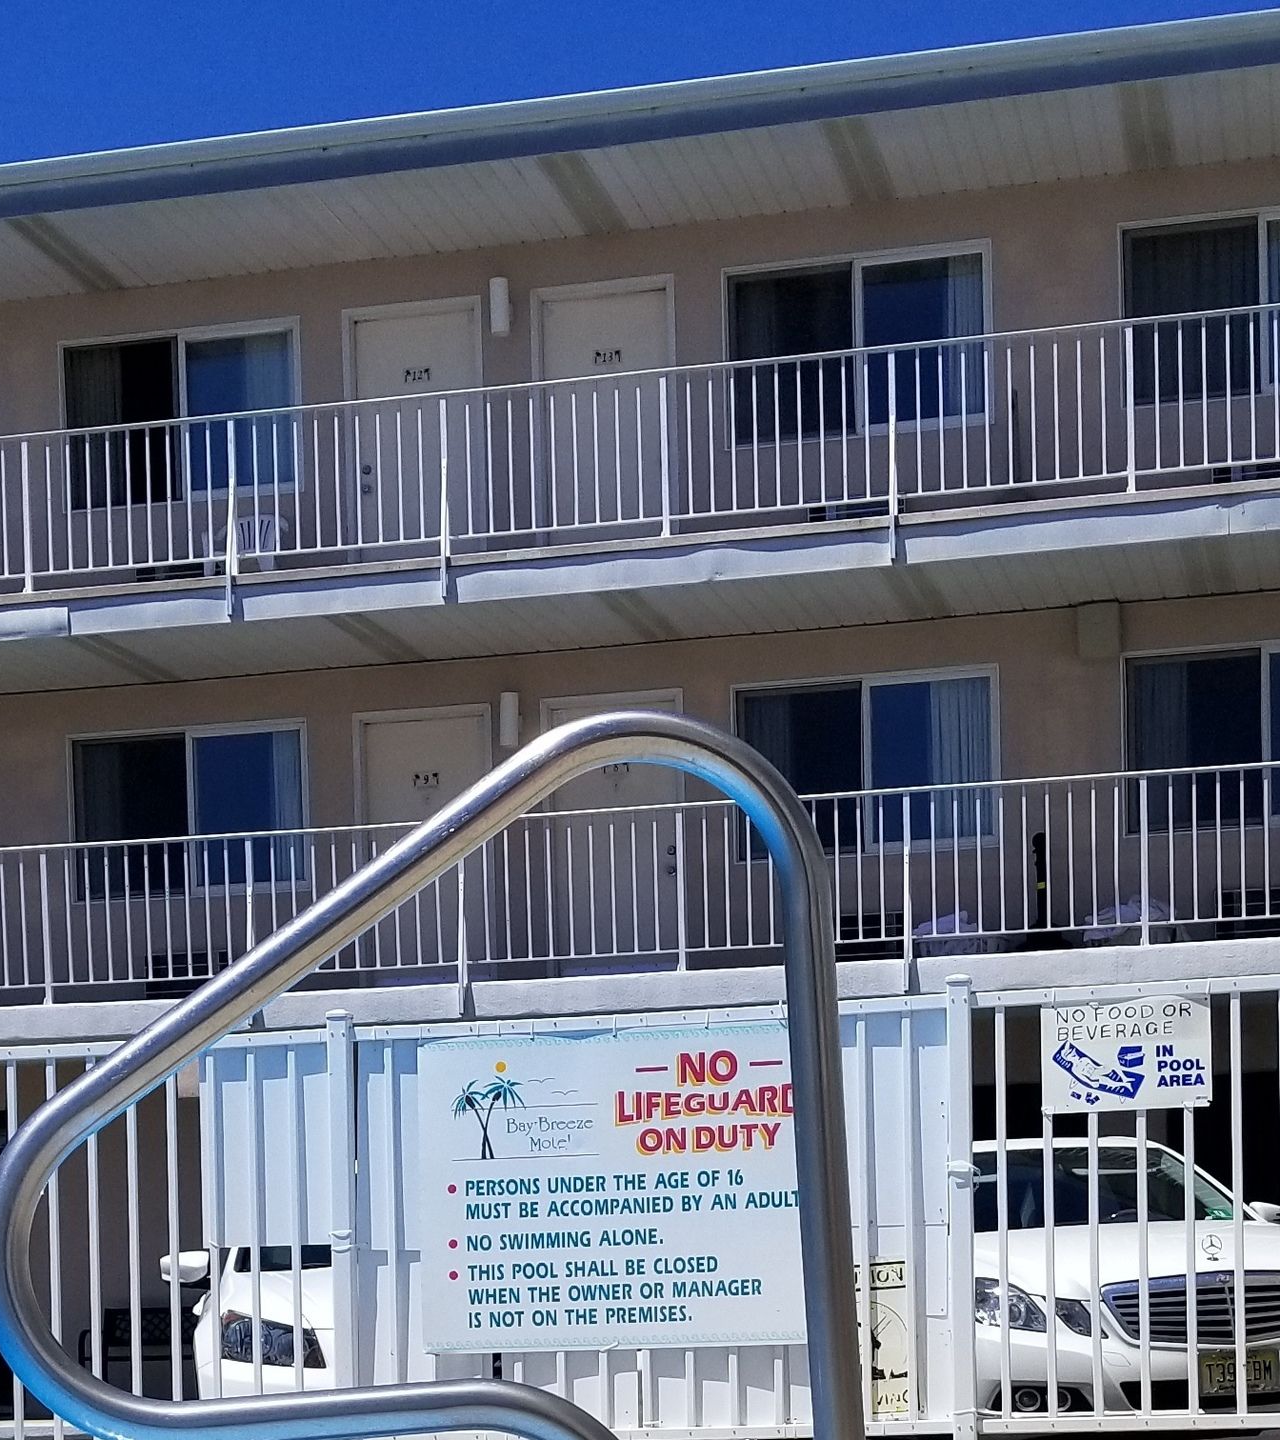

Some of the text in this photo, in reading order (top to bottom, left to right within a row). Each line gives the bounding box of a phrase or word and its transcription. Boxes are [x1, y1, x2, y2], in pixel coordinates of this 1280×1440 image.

[602, 352, 613, 362] 13
[424, 774, 429, 784] 9
[1056, 1002, 1192, 1025] NO FOOD OR
[1057, 1021, 1173, 1042] BEVERAGE
[1156, 1044, 1174, 1058] IN
[676, 1050, 738, 1087] NO
[1157, 1058, 1205, 1072] POOL
[1157, 1073, 1205, 1088] AREA
[614, 1083, 794, 1126] LIFEGUARD
[636, 1123, 782, 1156] ON DUTY
[465, 1169, 744, 1196] PERSONS UNDER THE AGE OF 16
[466, 1190, 800, 1220] MUST BE ACCOMPANIED BY AN ADULT
[466, 1228, 664, 1252] NO SWIMMING ALONE.
[468, 1256, 718, 1282] THIS POOL SHALL BE CLOSED
[468, 1278, 762, 1305] WHEN THE OWNER OR MANAGER
[468, 1305, 692, 1328] IS NOT ON THE PREMISES.
